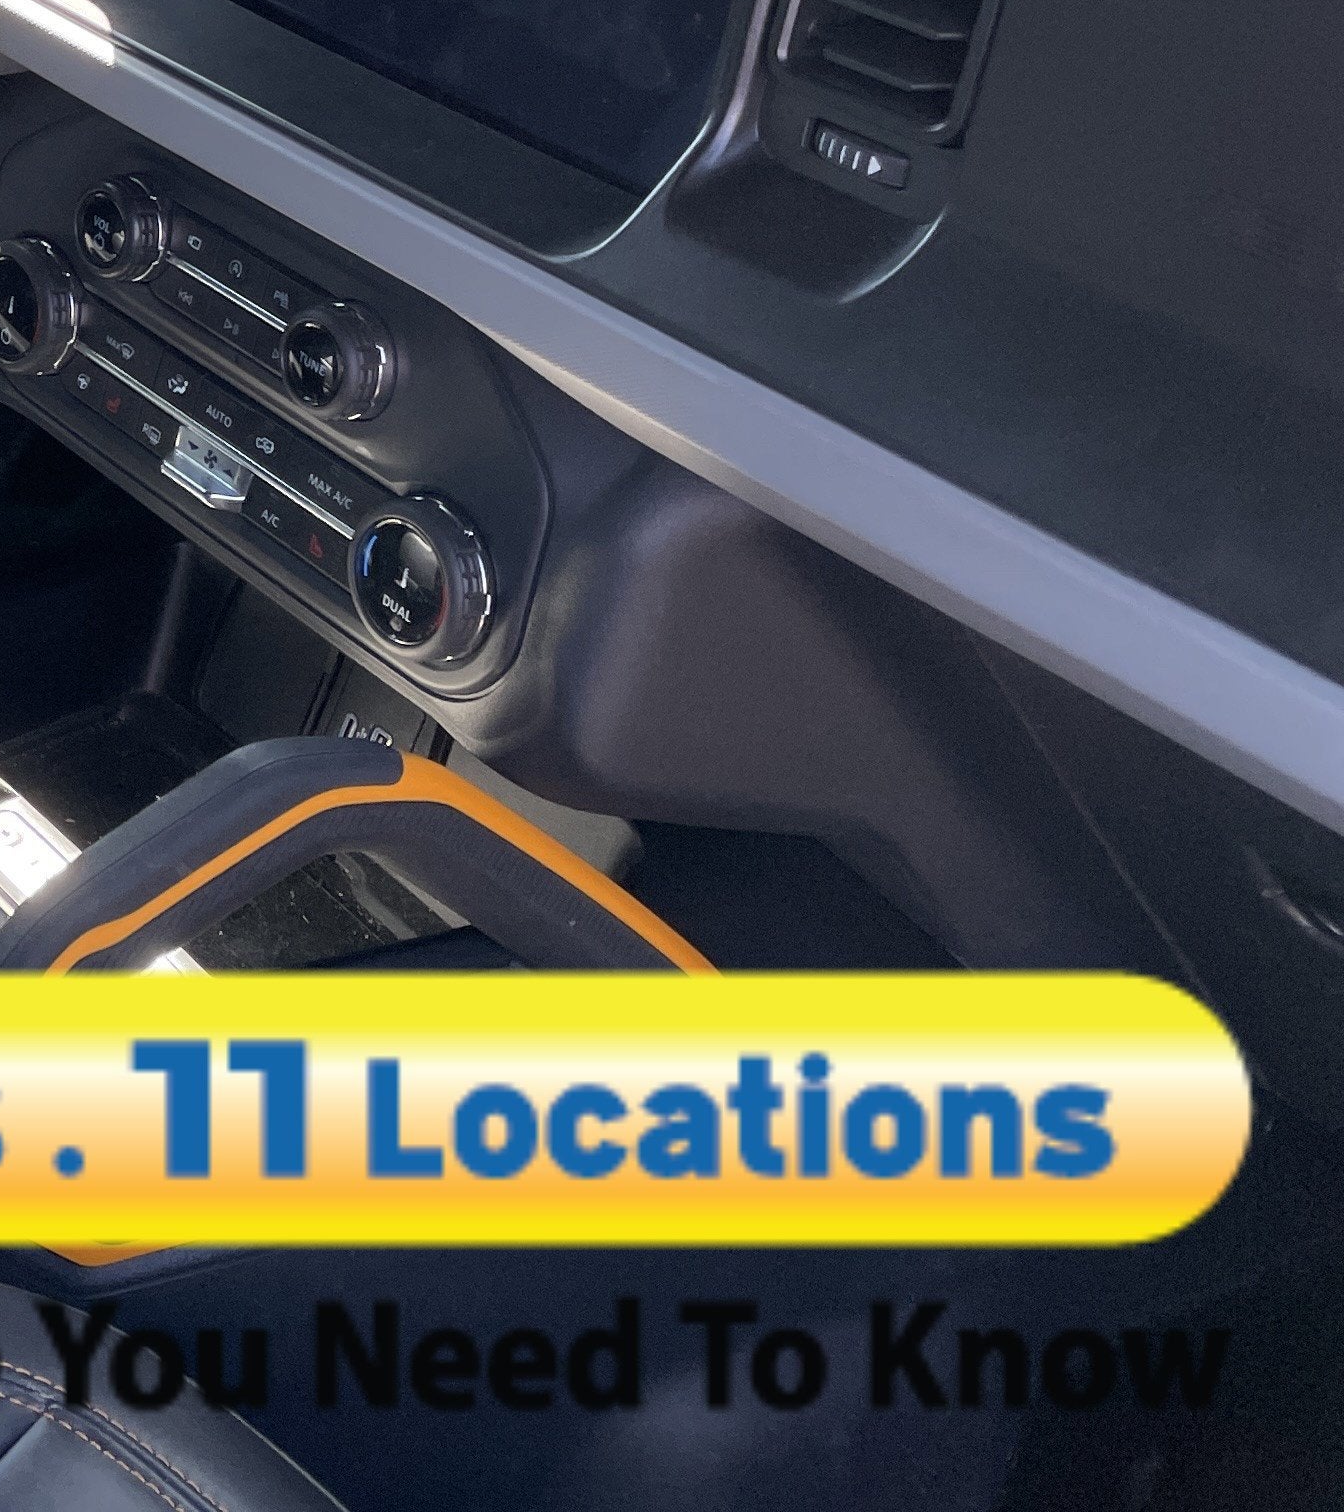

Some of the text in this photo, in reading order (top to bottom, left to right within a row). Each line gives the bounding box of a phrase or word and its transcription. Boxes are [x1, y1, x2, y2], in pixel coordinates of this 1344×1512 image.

[93, 214, 110, 234] VOL
[299, 350, 327, 377] TUNE
[205, 404, 233, 429] AUTO
[308, 473, 354, 511] MAX A/C
[260, 509, 280, 529] A/C
[381, 593, 412, 624] DUAL
